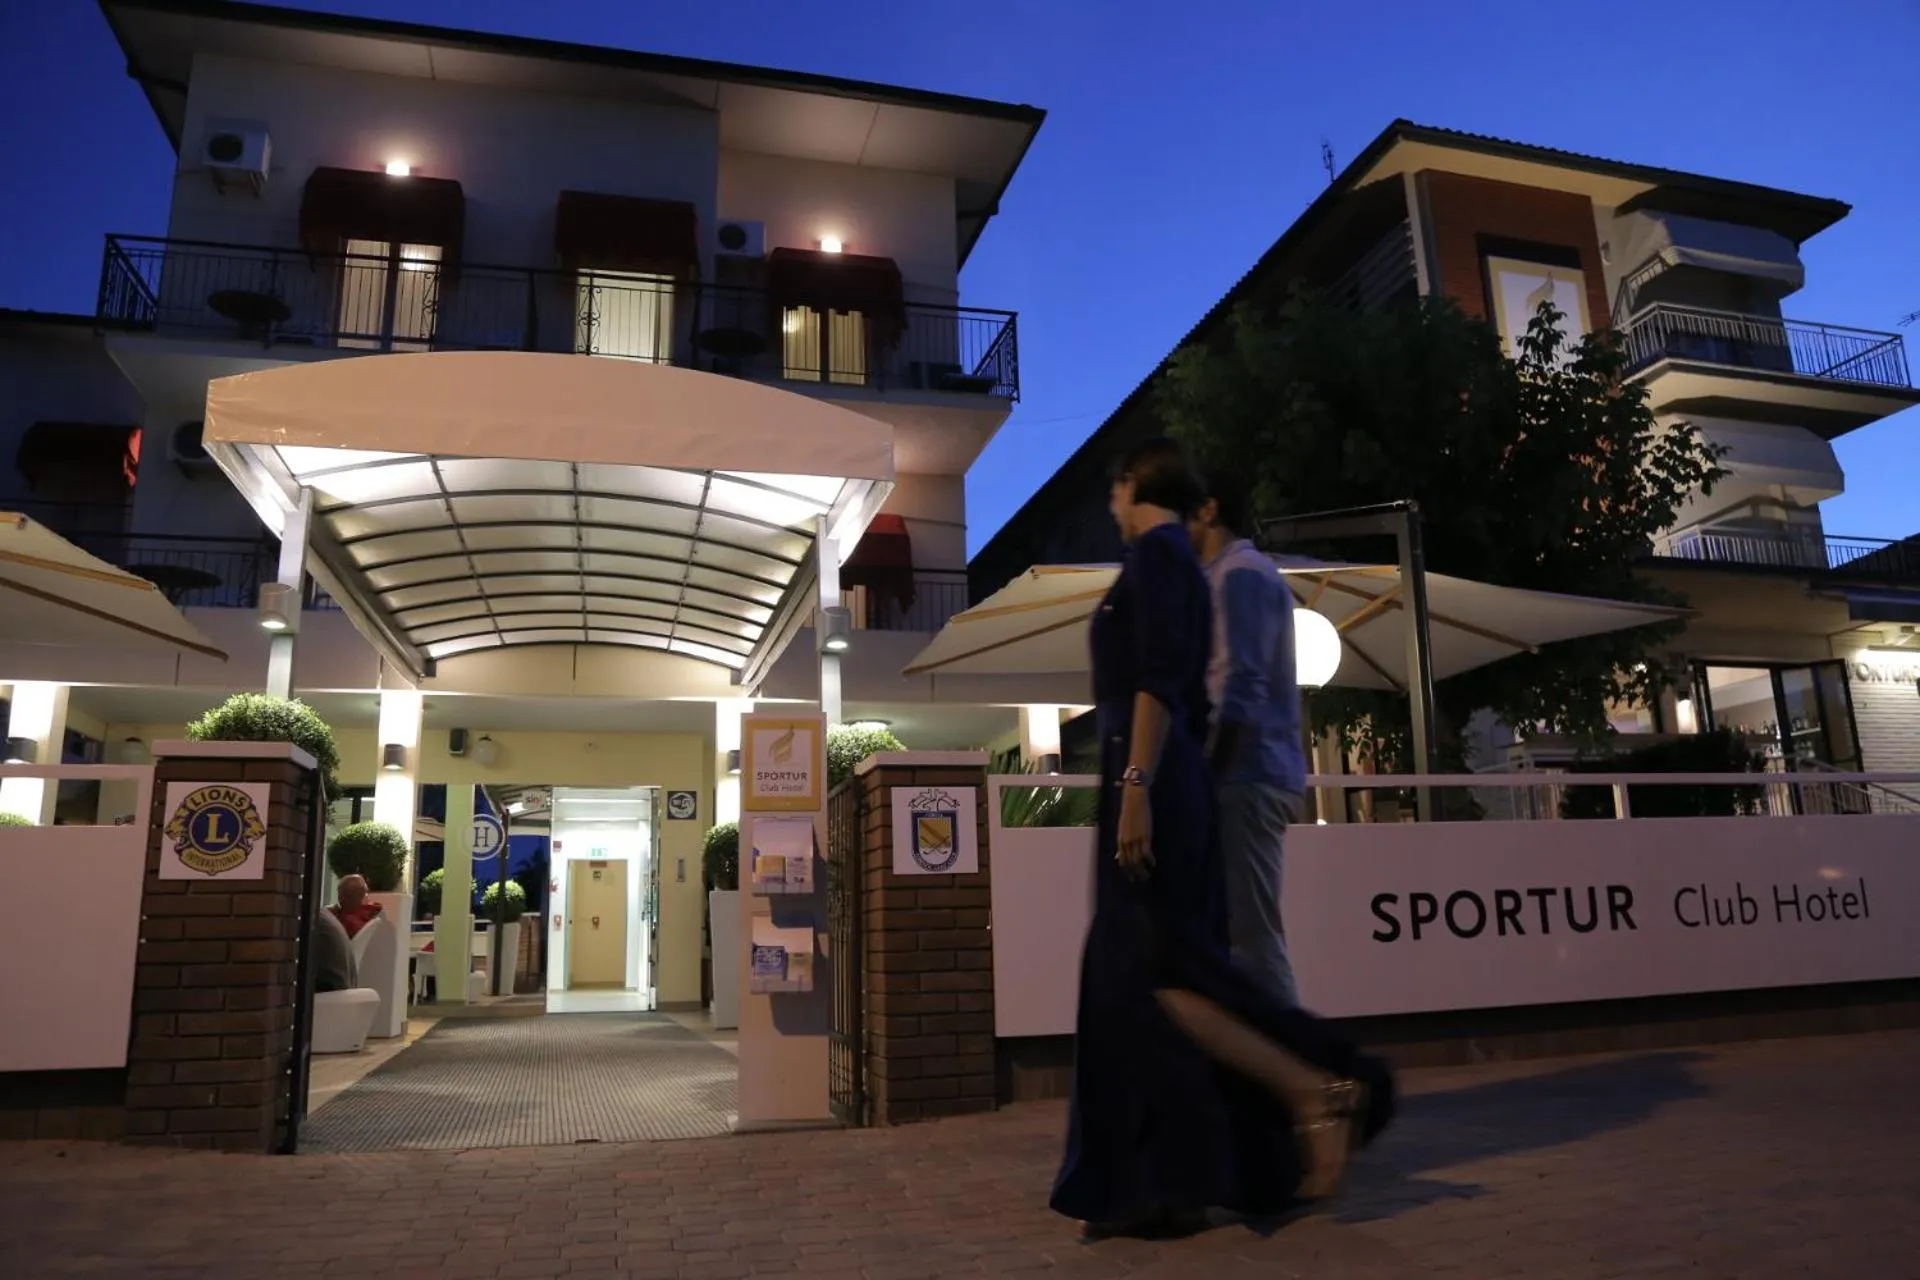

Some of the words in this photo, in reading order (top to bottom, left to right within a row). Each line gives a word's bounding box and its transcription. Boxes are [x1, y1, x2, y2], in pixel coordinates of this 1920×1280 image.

[757, 771, 808, 781] SPORTUR
[191, 789, 244, 807] LIONS
[204, 813, 229, 843] L
[473, 826, 490, 848] H
[1370, 885, 1638, 943] SPORTUR
[1674, 881, 1759, 928] Club
[1772, 876, 1870, 924] Hotel
